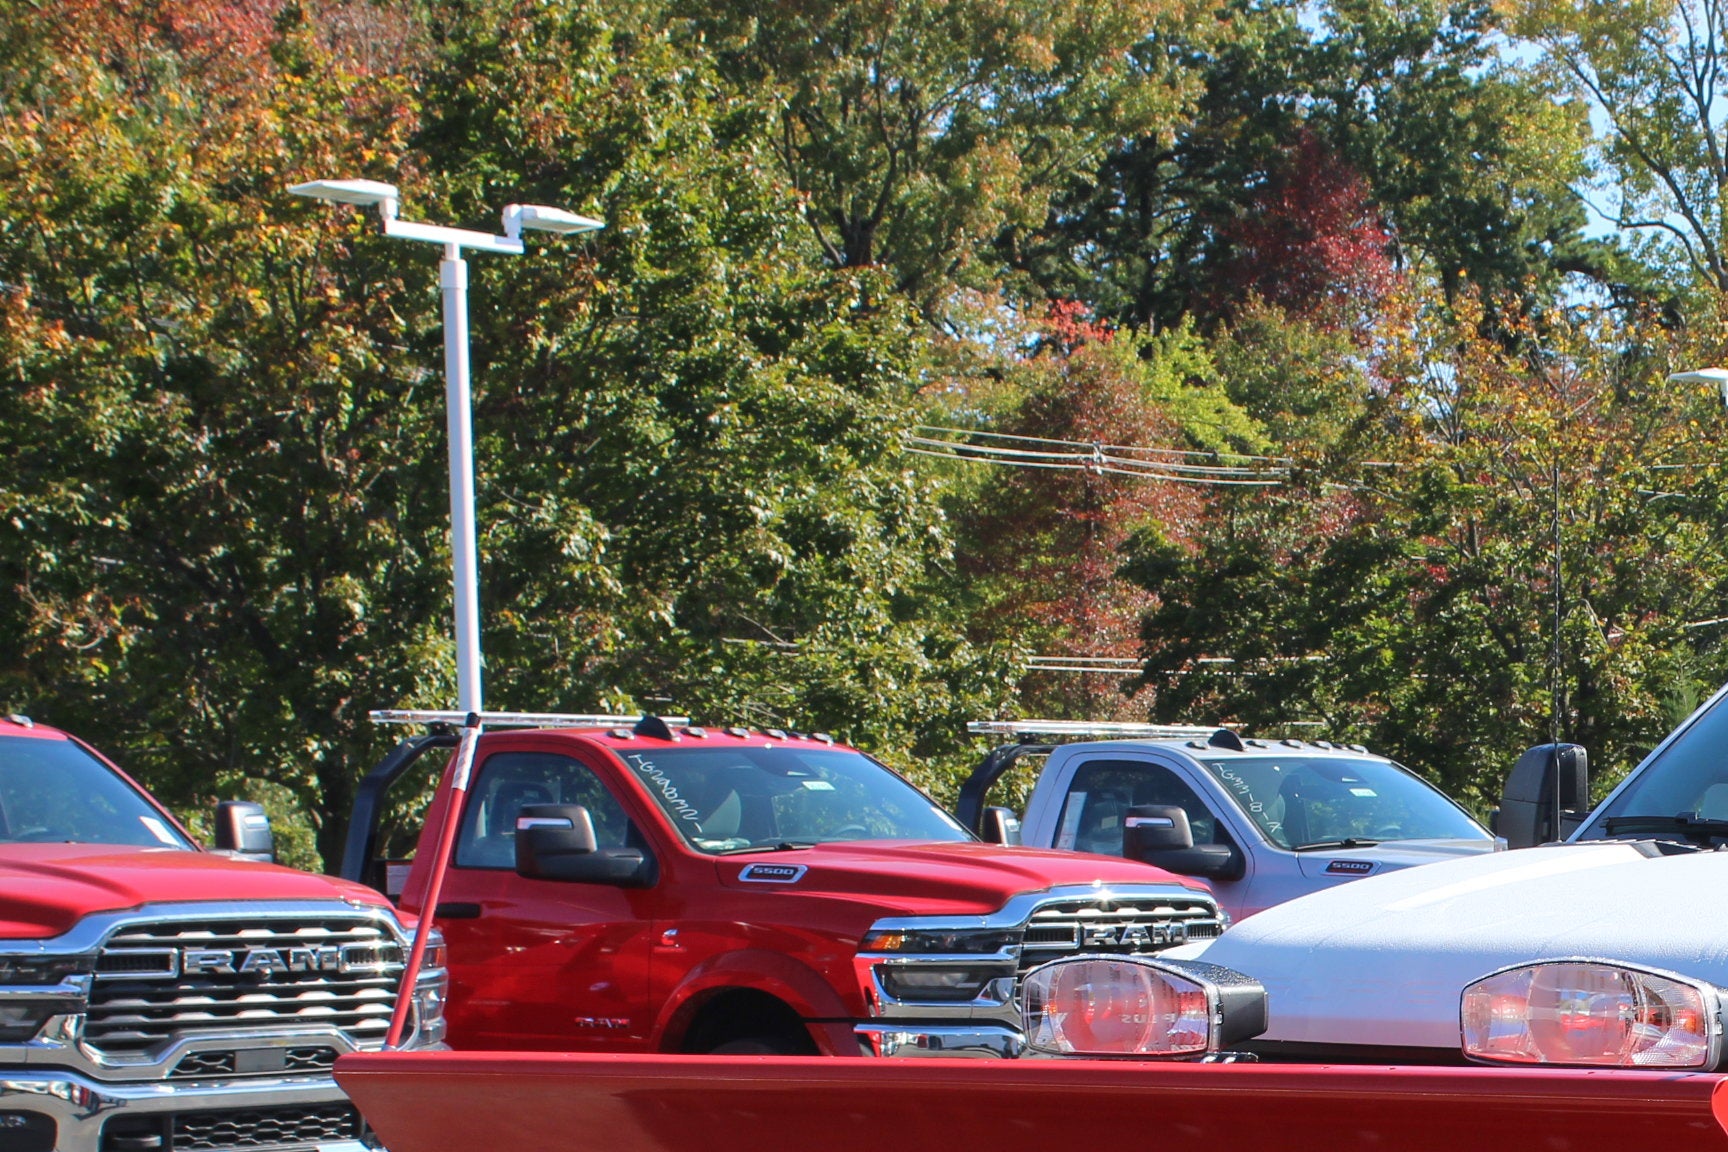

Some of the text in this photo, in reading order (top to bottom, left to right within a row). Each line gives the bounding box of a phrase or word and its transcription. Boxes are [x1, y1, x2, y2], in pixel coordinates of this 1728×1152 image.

[752, 865, 795, 876] 5500
[1331, 862, 1371, 871] 5500
[1082, 922, 1184, 946] RAM
[183, 948, 337, 975] RAM
